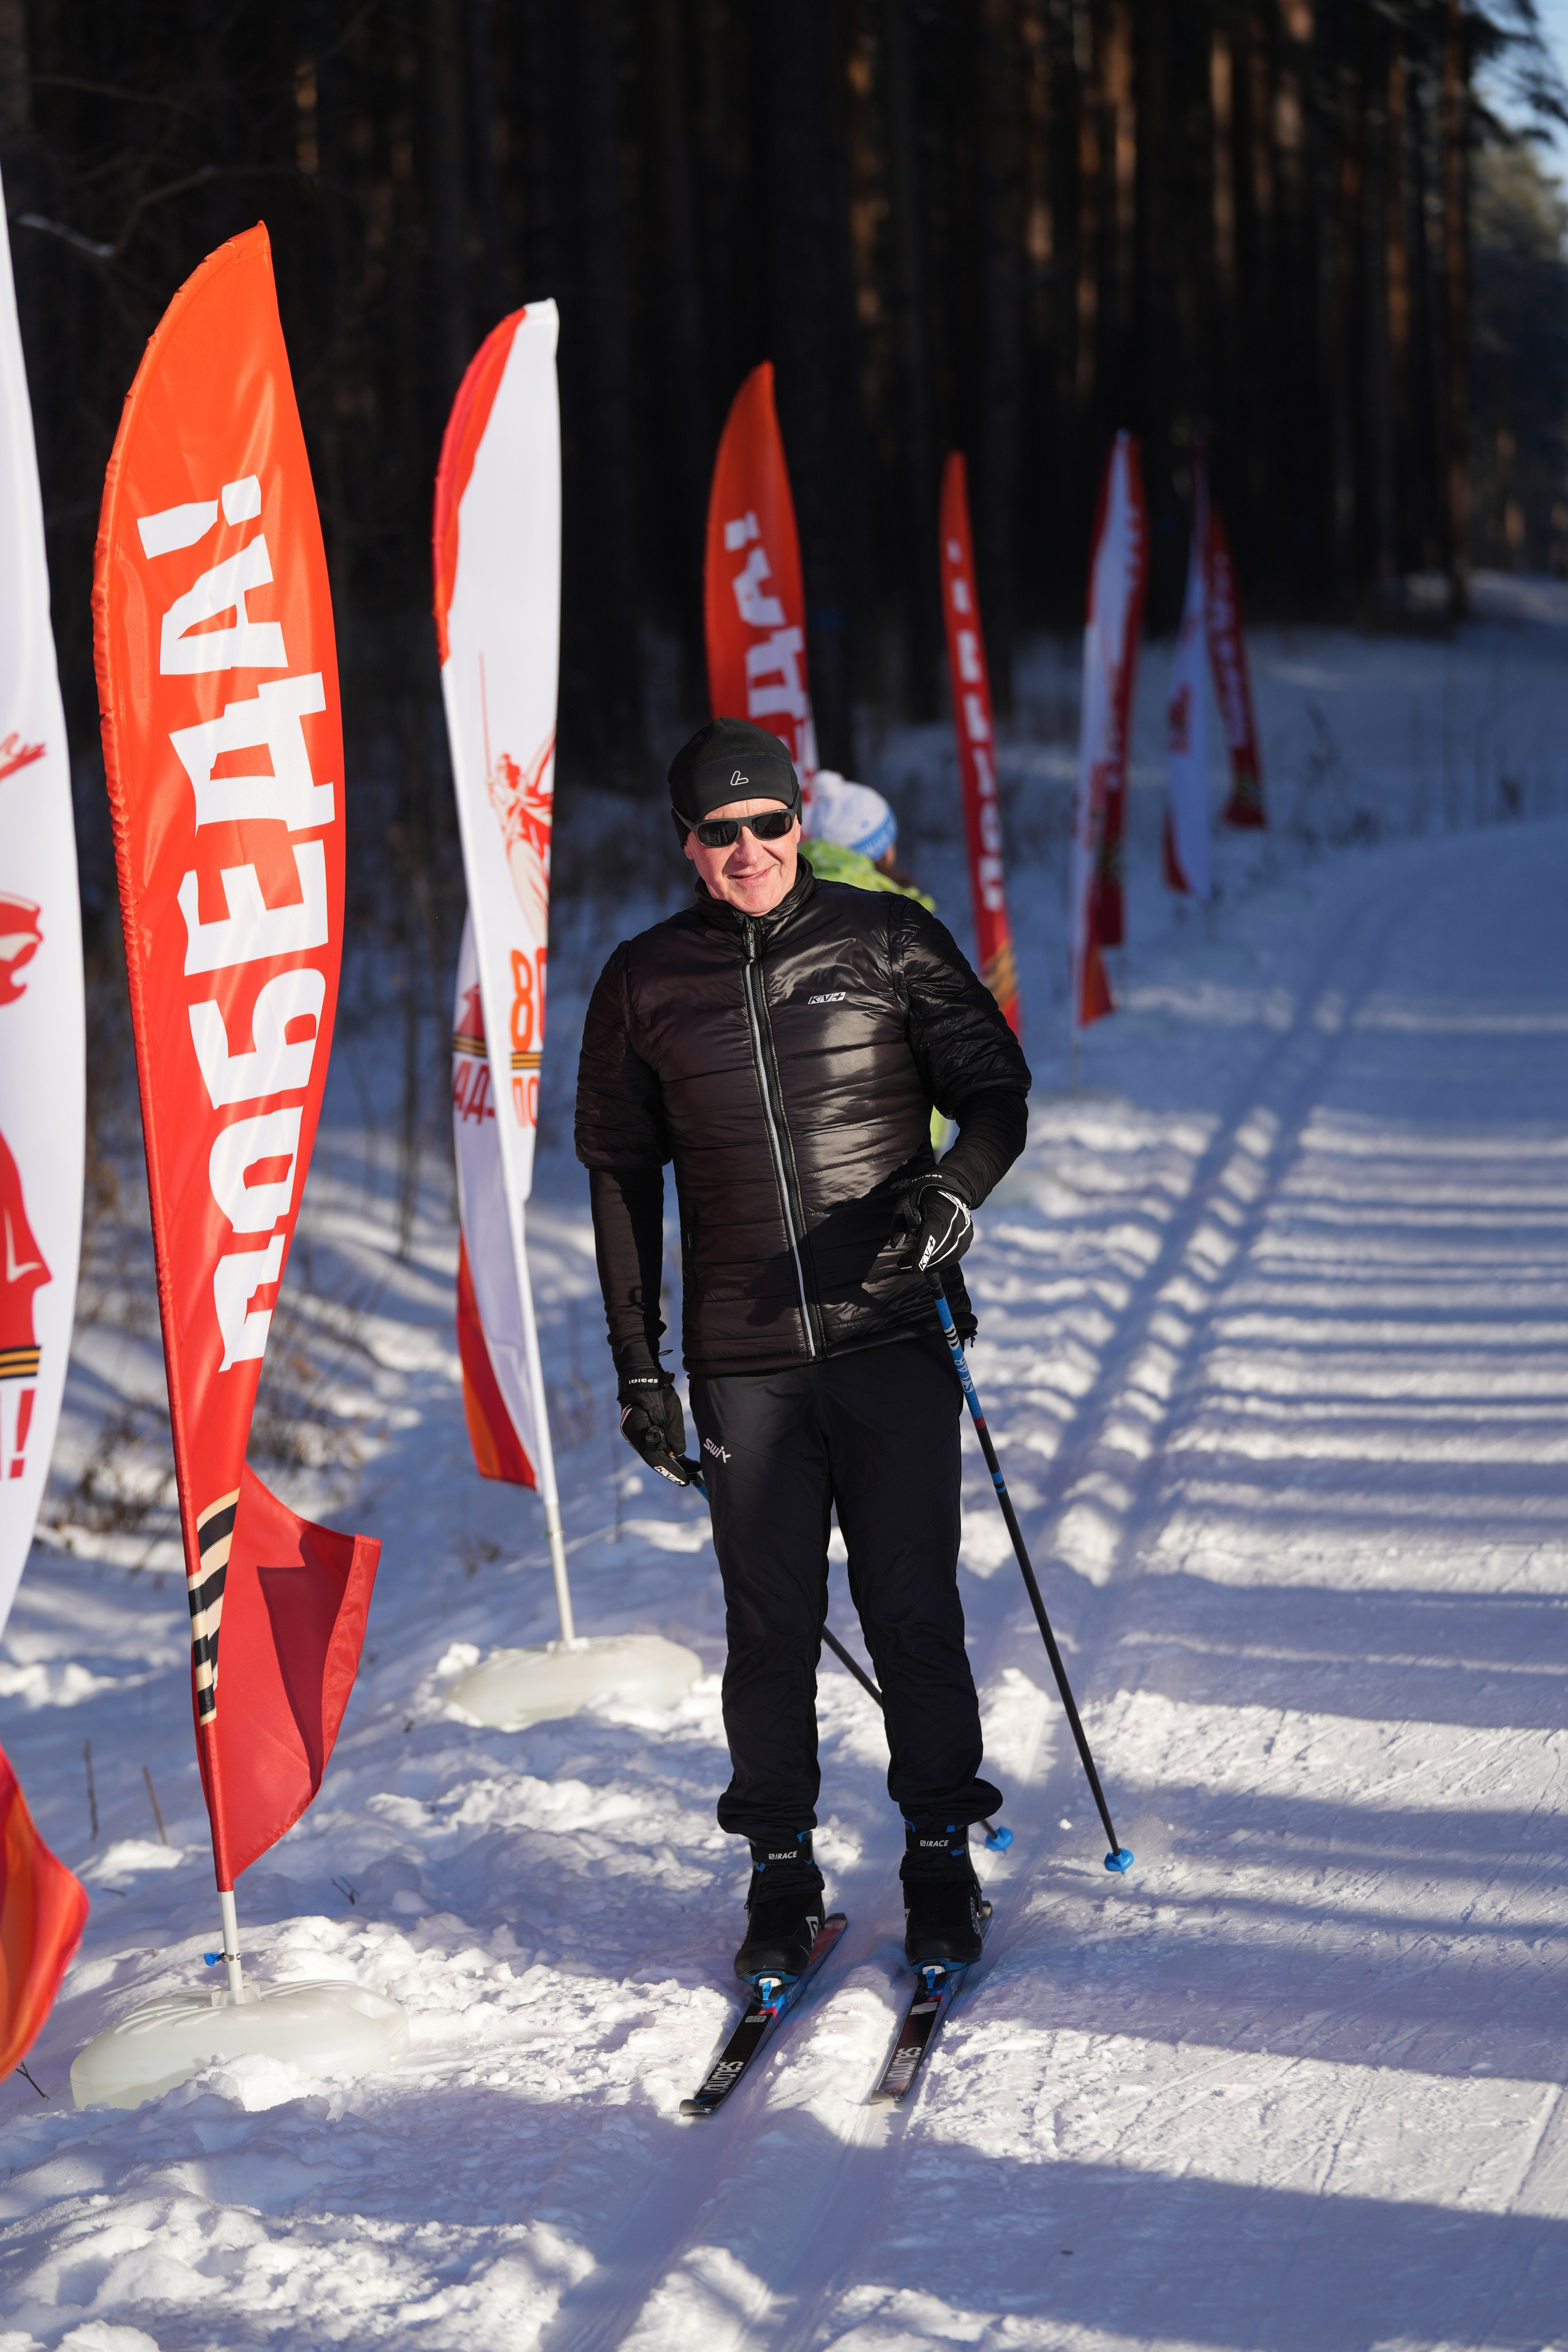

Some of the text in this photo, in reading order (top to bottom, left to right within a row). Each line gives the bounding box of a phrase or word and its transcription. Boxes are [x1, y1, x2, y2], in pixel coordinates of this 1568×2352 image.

[137, 474, 336, 1373] ПОБЕДА!
[807, 991, 846, 1005] KV+
[919, 1235, 936, 1272] KV+
